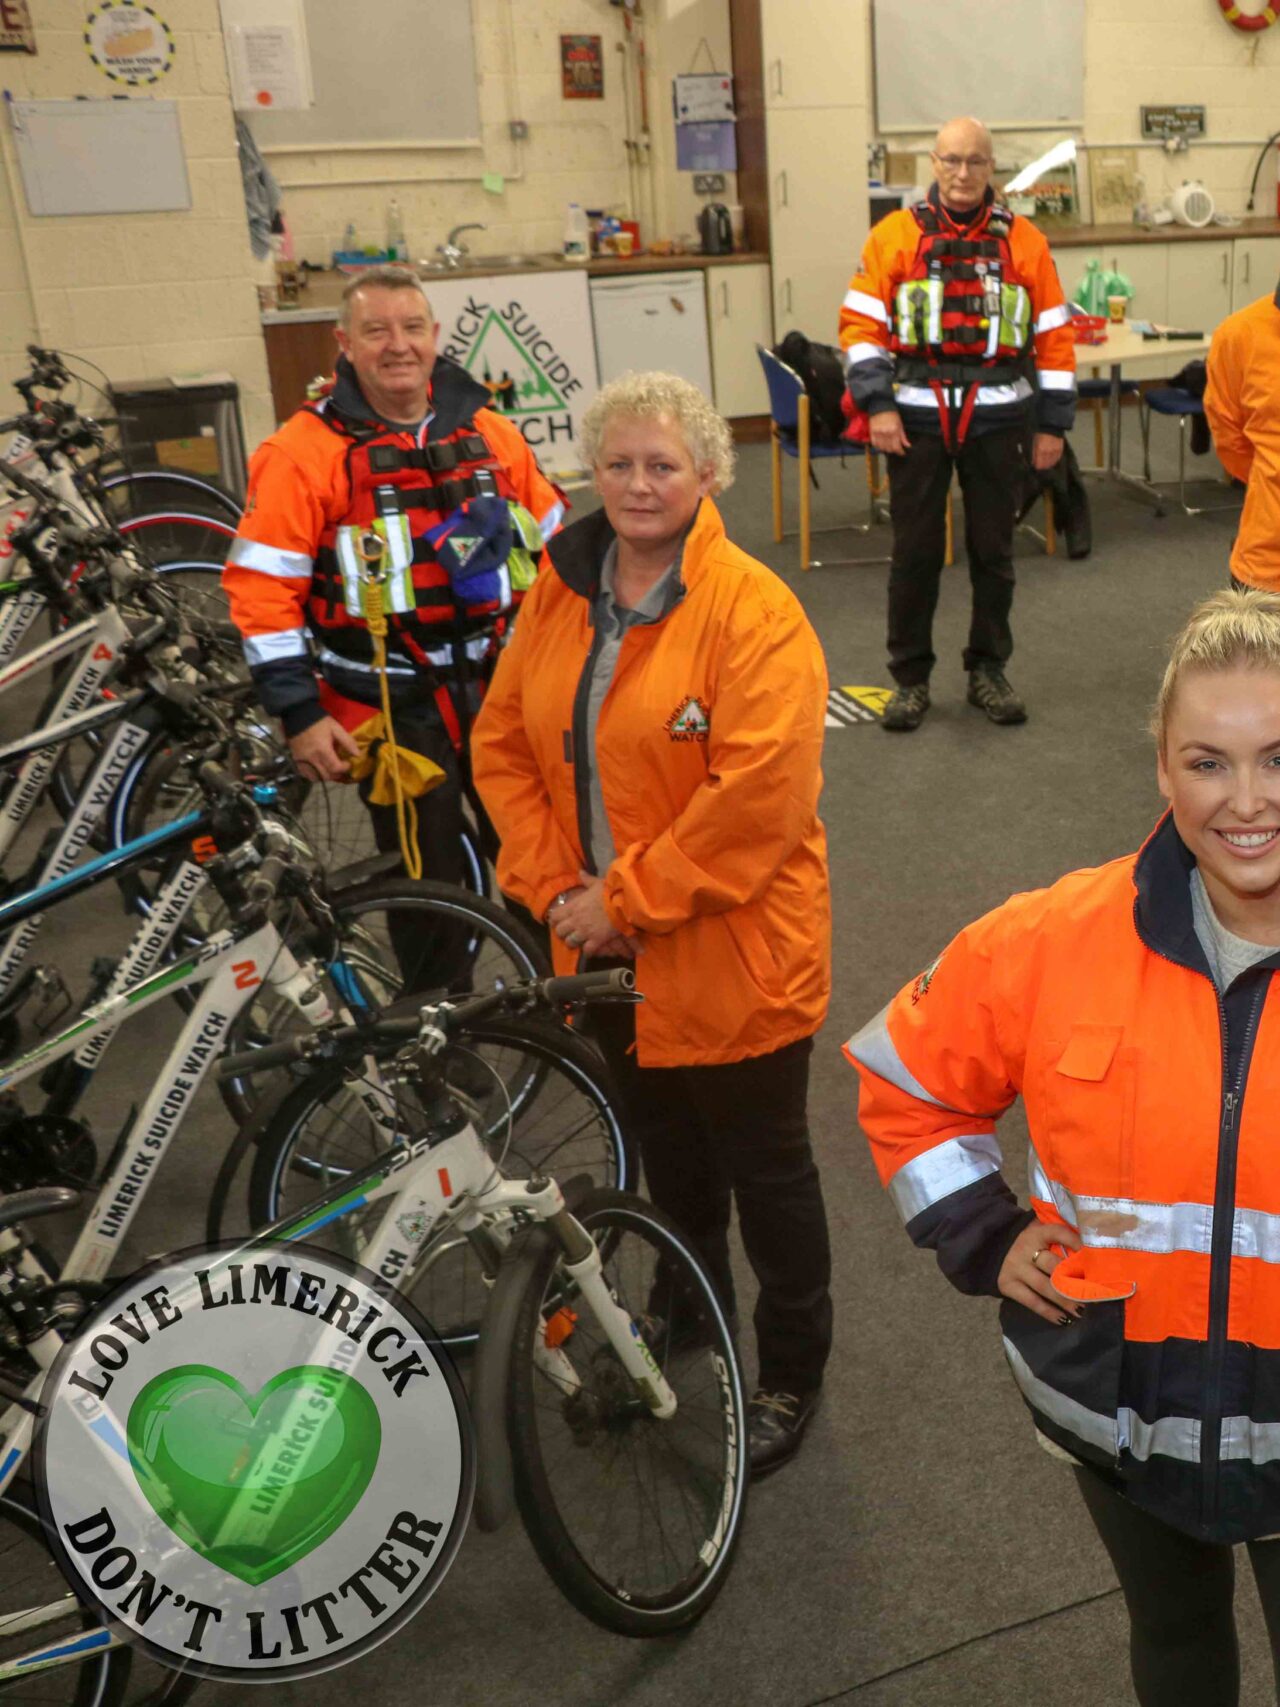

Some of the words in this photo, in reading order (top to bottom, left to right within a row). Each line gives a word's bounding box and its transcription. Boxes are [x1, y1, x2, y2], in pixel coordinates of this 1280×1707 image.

[501, 300, 582, 399] SUICIDE
[2, 587, 43, 659] WATCH
[68, 667, 99, 713] WATCH
[9, 757, 48, 822] LIMERICK
[91, 728, 142, 806] WATCH
[125, 925, 168, 988] SUICIDE
[161, 869, 201, 926] WATCH
[98, 1152, 155, 1238] LIMERICK
[144, 1077, 193, 1150] SUICIDE
[181, 1011, 228, 1076] WATCH
[250, 1411, 320, 1516] LIMERICK
